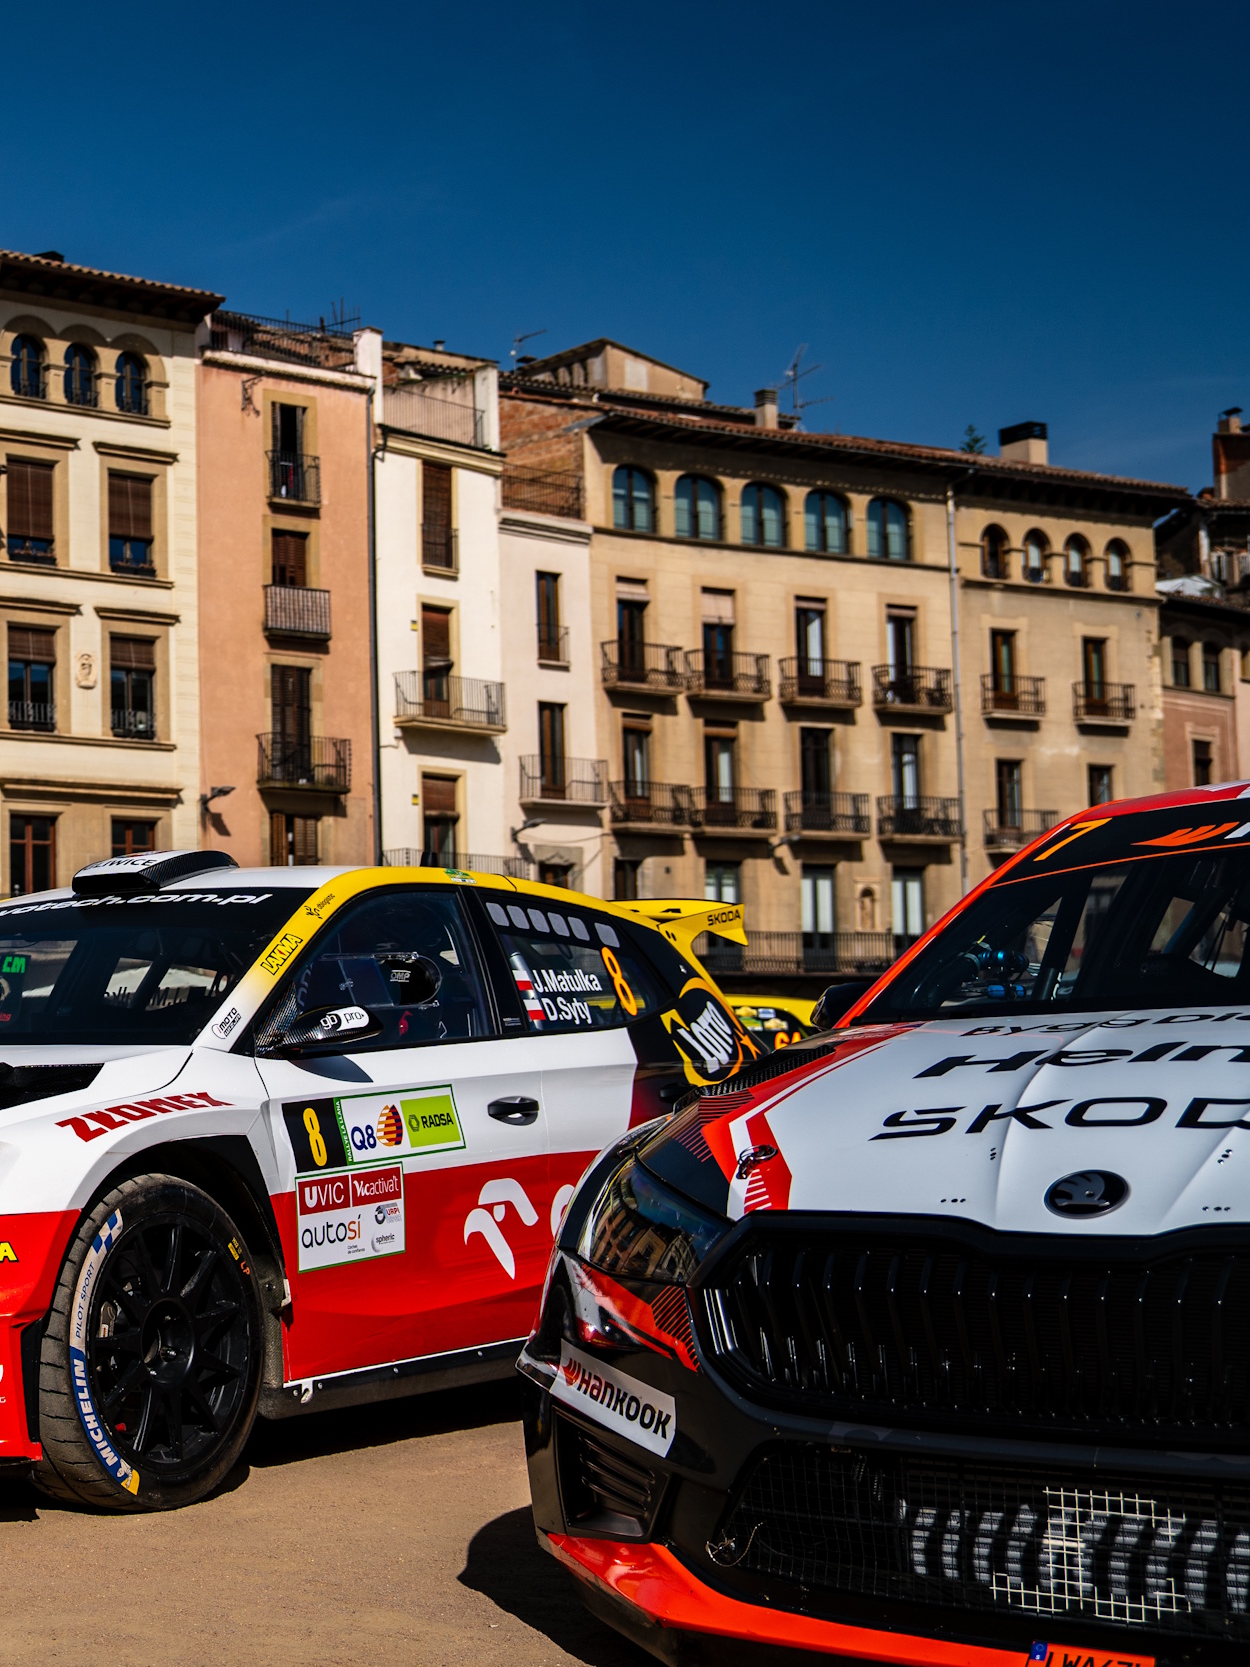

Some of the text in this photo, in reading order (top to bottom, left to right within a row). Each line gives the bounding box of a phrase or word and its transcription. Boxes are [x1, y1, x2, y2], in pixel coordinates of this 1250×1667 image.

[1033, 817, 1113, 862] 7
[707, 909, 741, 926] SKODA
[260, 933, 303, 976] LAKMA
[532, 969, 603, 993] J.Matulka
[601, 946, 638, 1017] 8
[541, 996, 593, 1025] D.Syty
[677, 1001, 733, 1074] LOTTO
[303, 1107, 327, 1167] 8
[351, 1124, 377, 1151] Q8
[421, 1112, 453, 1129] RADSA
[304, 1181, 345, 1208] UVIC
[301, 1213, 362, 1249] autosí
[75, 1261, 94, 1339] PILOT SPORT
[73, 1359, 118, 1467] MICHELIN
